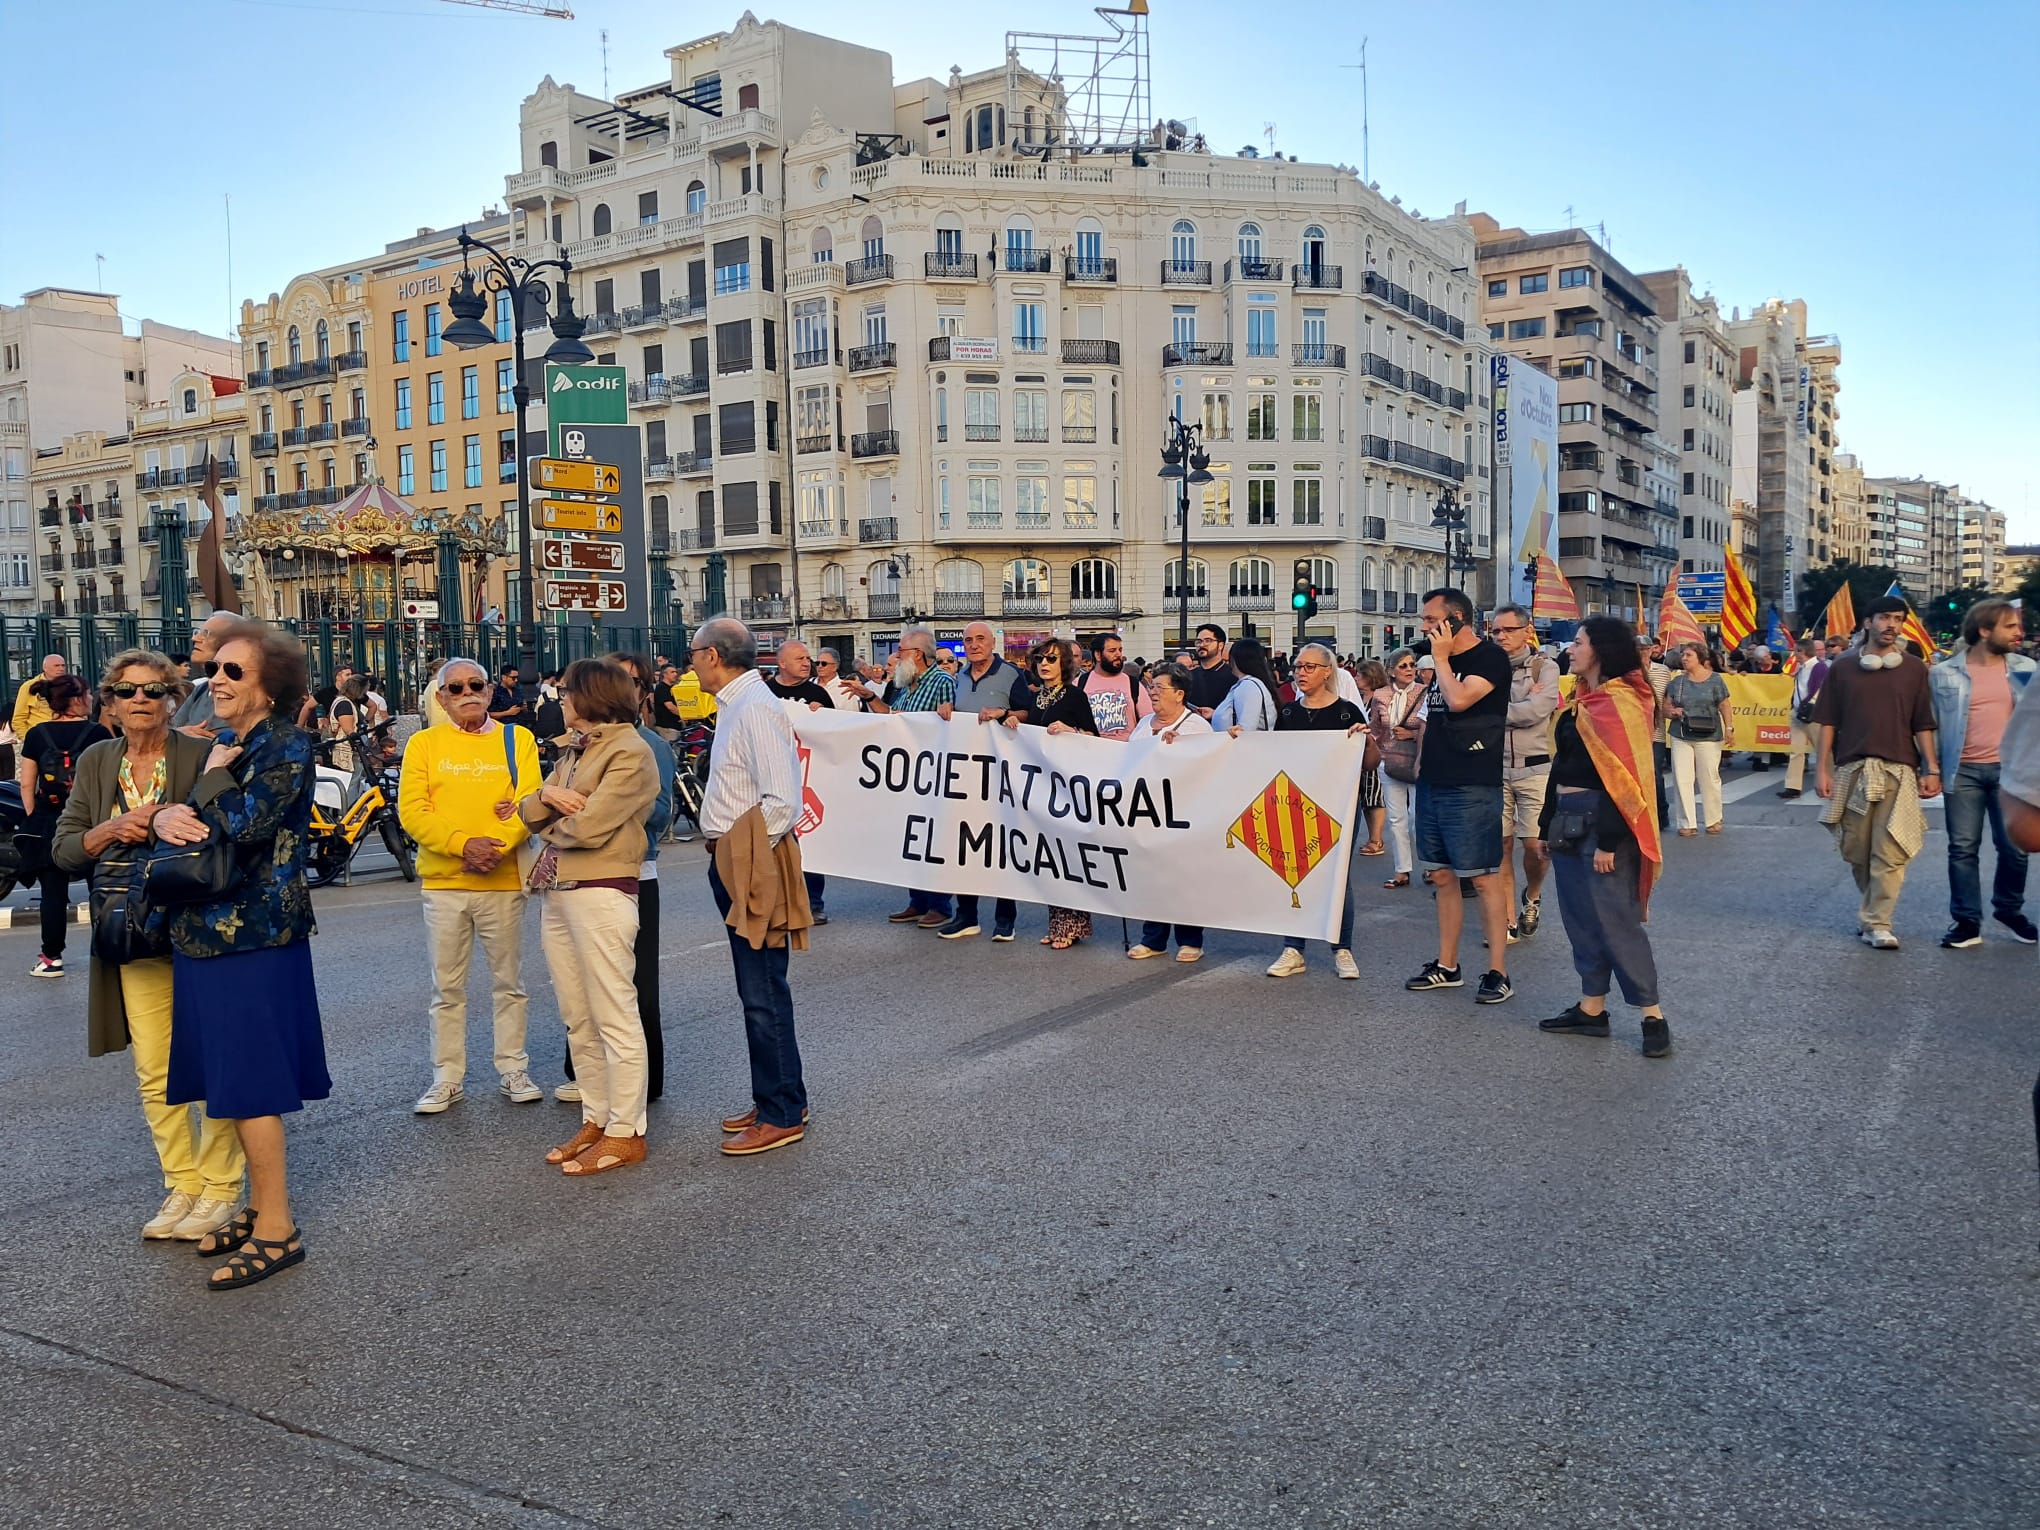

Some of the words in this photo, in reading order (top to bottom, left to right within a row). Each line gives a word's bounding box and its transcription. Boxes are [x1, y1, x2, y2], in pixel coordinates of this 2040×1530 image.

[398, 275, 443, 299] HOTEL
[452, 263, 494, 288] ZNIT
[576, 376, 622, 390] adif
[1539, 385, 1553, 409] Nou
[940, 631, 964, 639] EXCHA
[1089, 692, 1116, 705] JUST
[1731, 703, 1789, 717] valenc
[1760, 730, 1791, 740] Decid
[438, 758, 472, 776] Pepe
[859, 745, 1042, 811] SOCIETAT
[1047, 771, 1191, 829] CORAL
[1251, 808, 1263, 821] EL
[1270, 795, 1320, 820] MICALET
[902, 814, 945, 865] EL
[958, 820, 1129, 892] MICALET
[1251, 831, 1292, 862] SOCIETAT
[1298, 835, 1323, 860] CORAL
